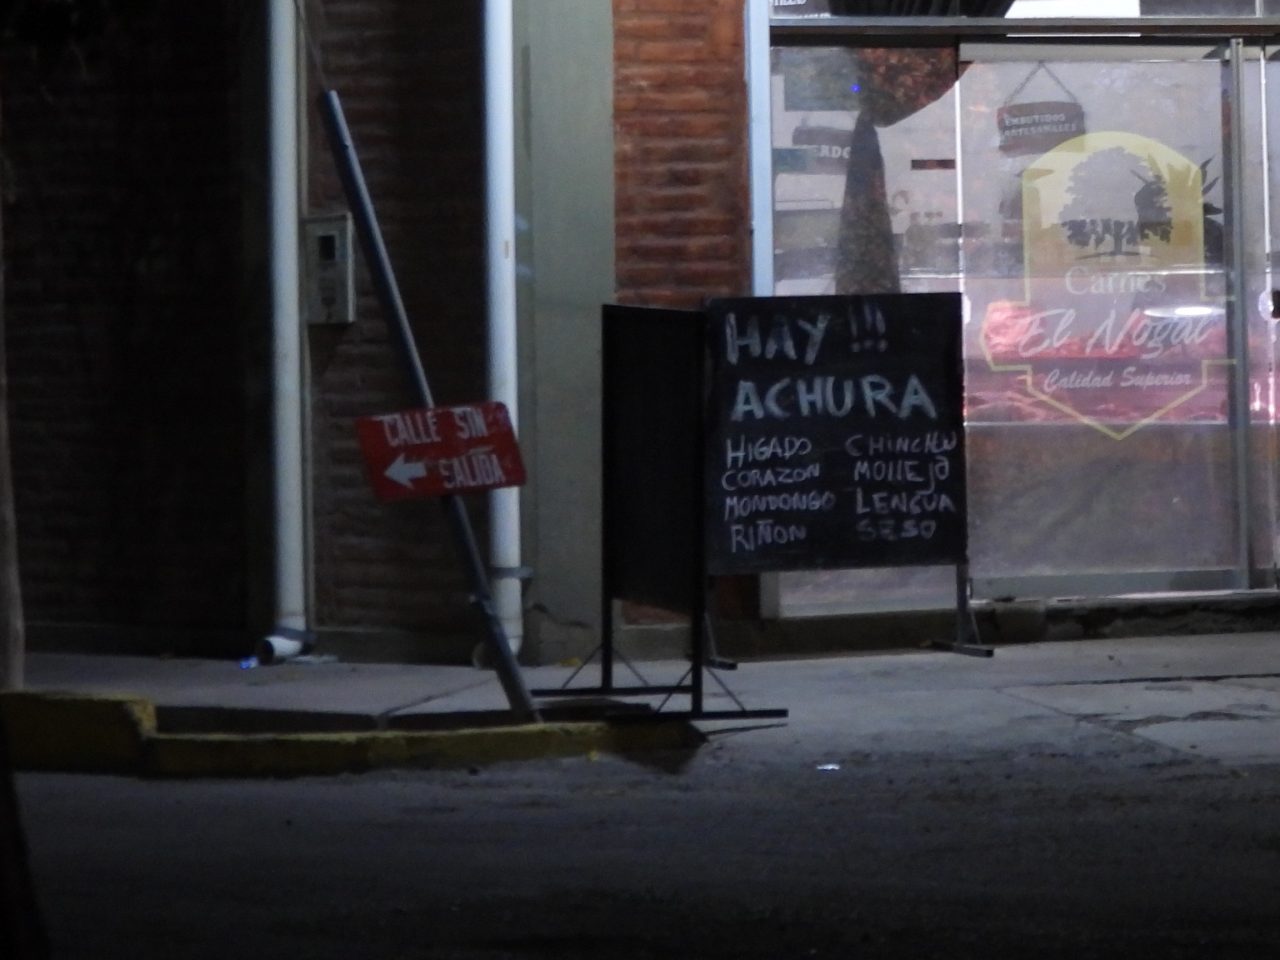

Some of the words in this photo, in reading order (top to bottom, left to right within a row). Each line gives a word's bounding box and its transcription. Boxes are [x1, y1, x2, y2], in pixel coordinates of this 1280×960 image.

[1065, 265, 1167, 295] Carnes
[725, 312, 832, 366] HAY
[1017, 308, 1076, 358] El
[1085, 307, 1216, 360] Nogal
[1044, 368, 1113, 392] Calidad
[1120, 366, 1192, 390] Superior
[730, 373, 938, 422] ACHURA
[382, 410, 442, 447] CALLE
[453, 407, 489, 440] SIN
[438, 453, 507, 489] SALIDA
[721, 462, 821, 491] CORAZON
[724, 490, 836, 521] MONDONGO
